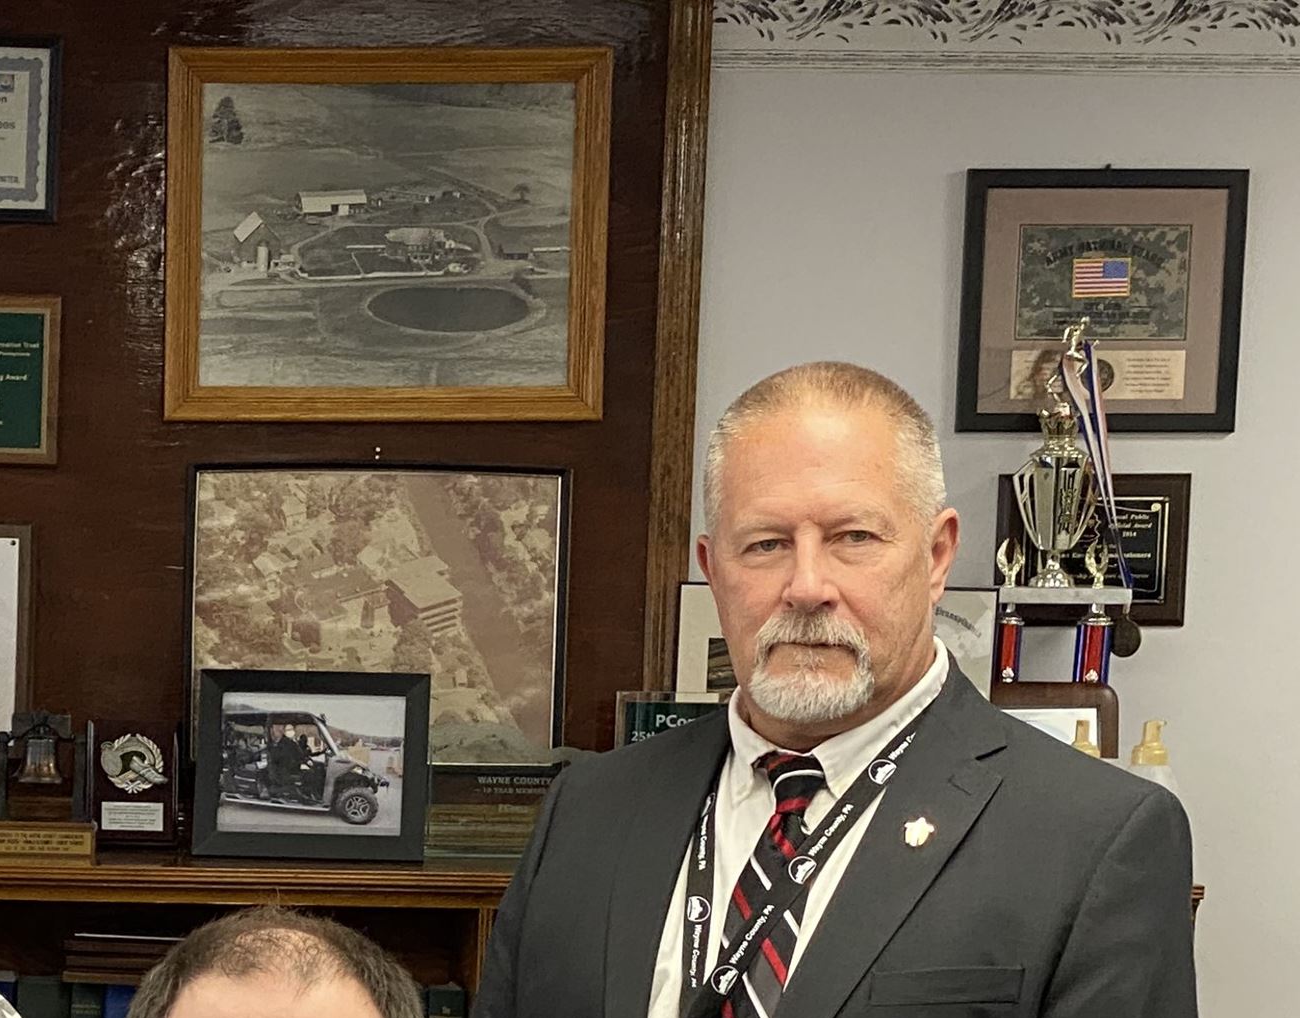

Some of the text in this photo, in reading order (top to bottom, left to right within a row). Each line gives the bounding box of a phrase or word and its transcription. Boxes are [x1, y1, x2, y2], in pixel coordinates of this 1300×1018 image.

[889, 741, 910, 761] Wayne
[478, 776, 551, 785] WAYNE COUNTY
[808, 804, 854, 856] Wayne County, PA
[693, 924, 702, 948] Wayne
[729, 904, 774, 964] Wayne County, PA
